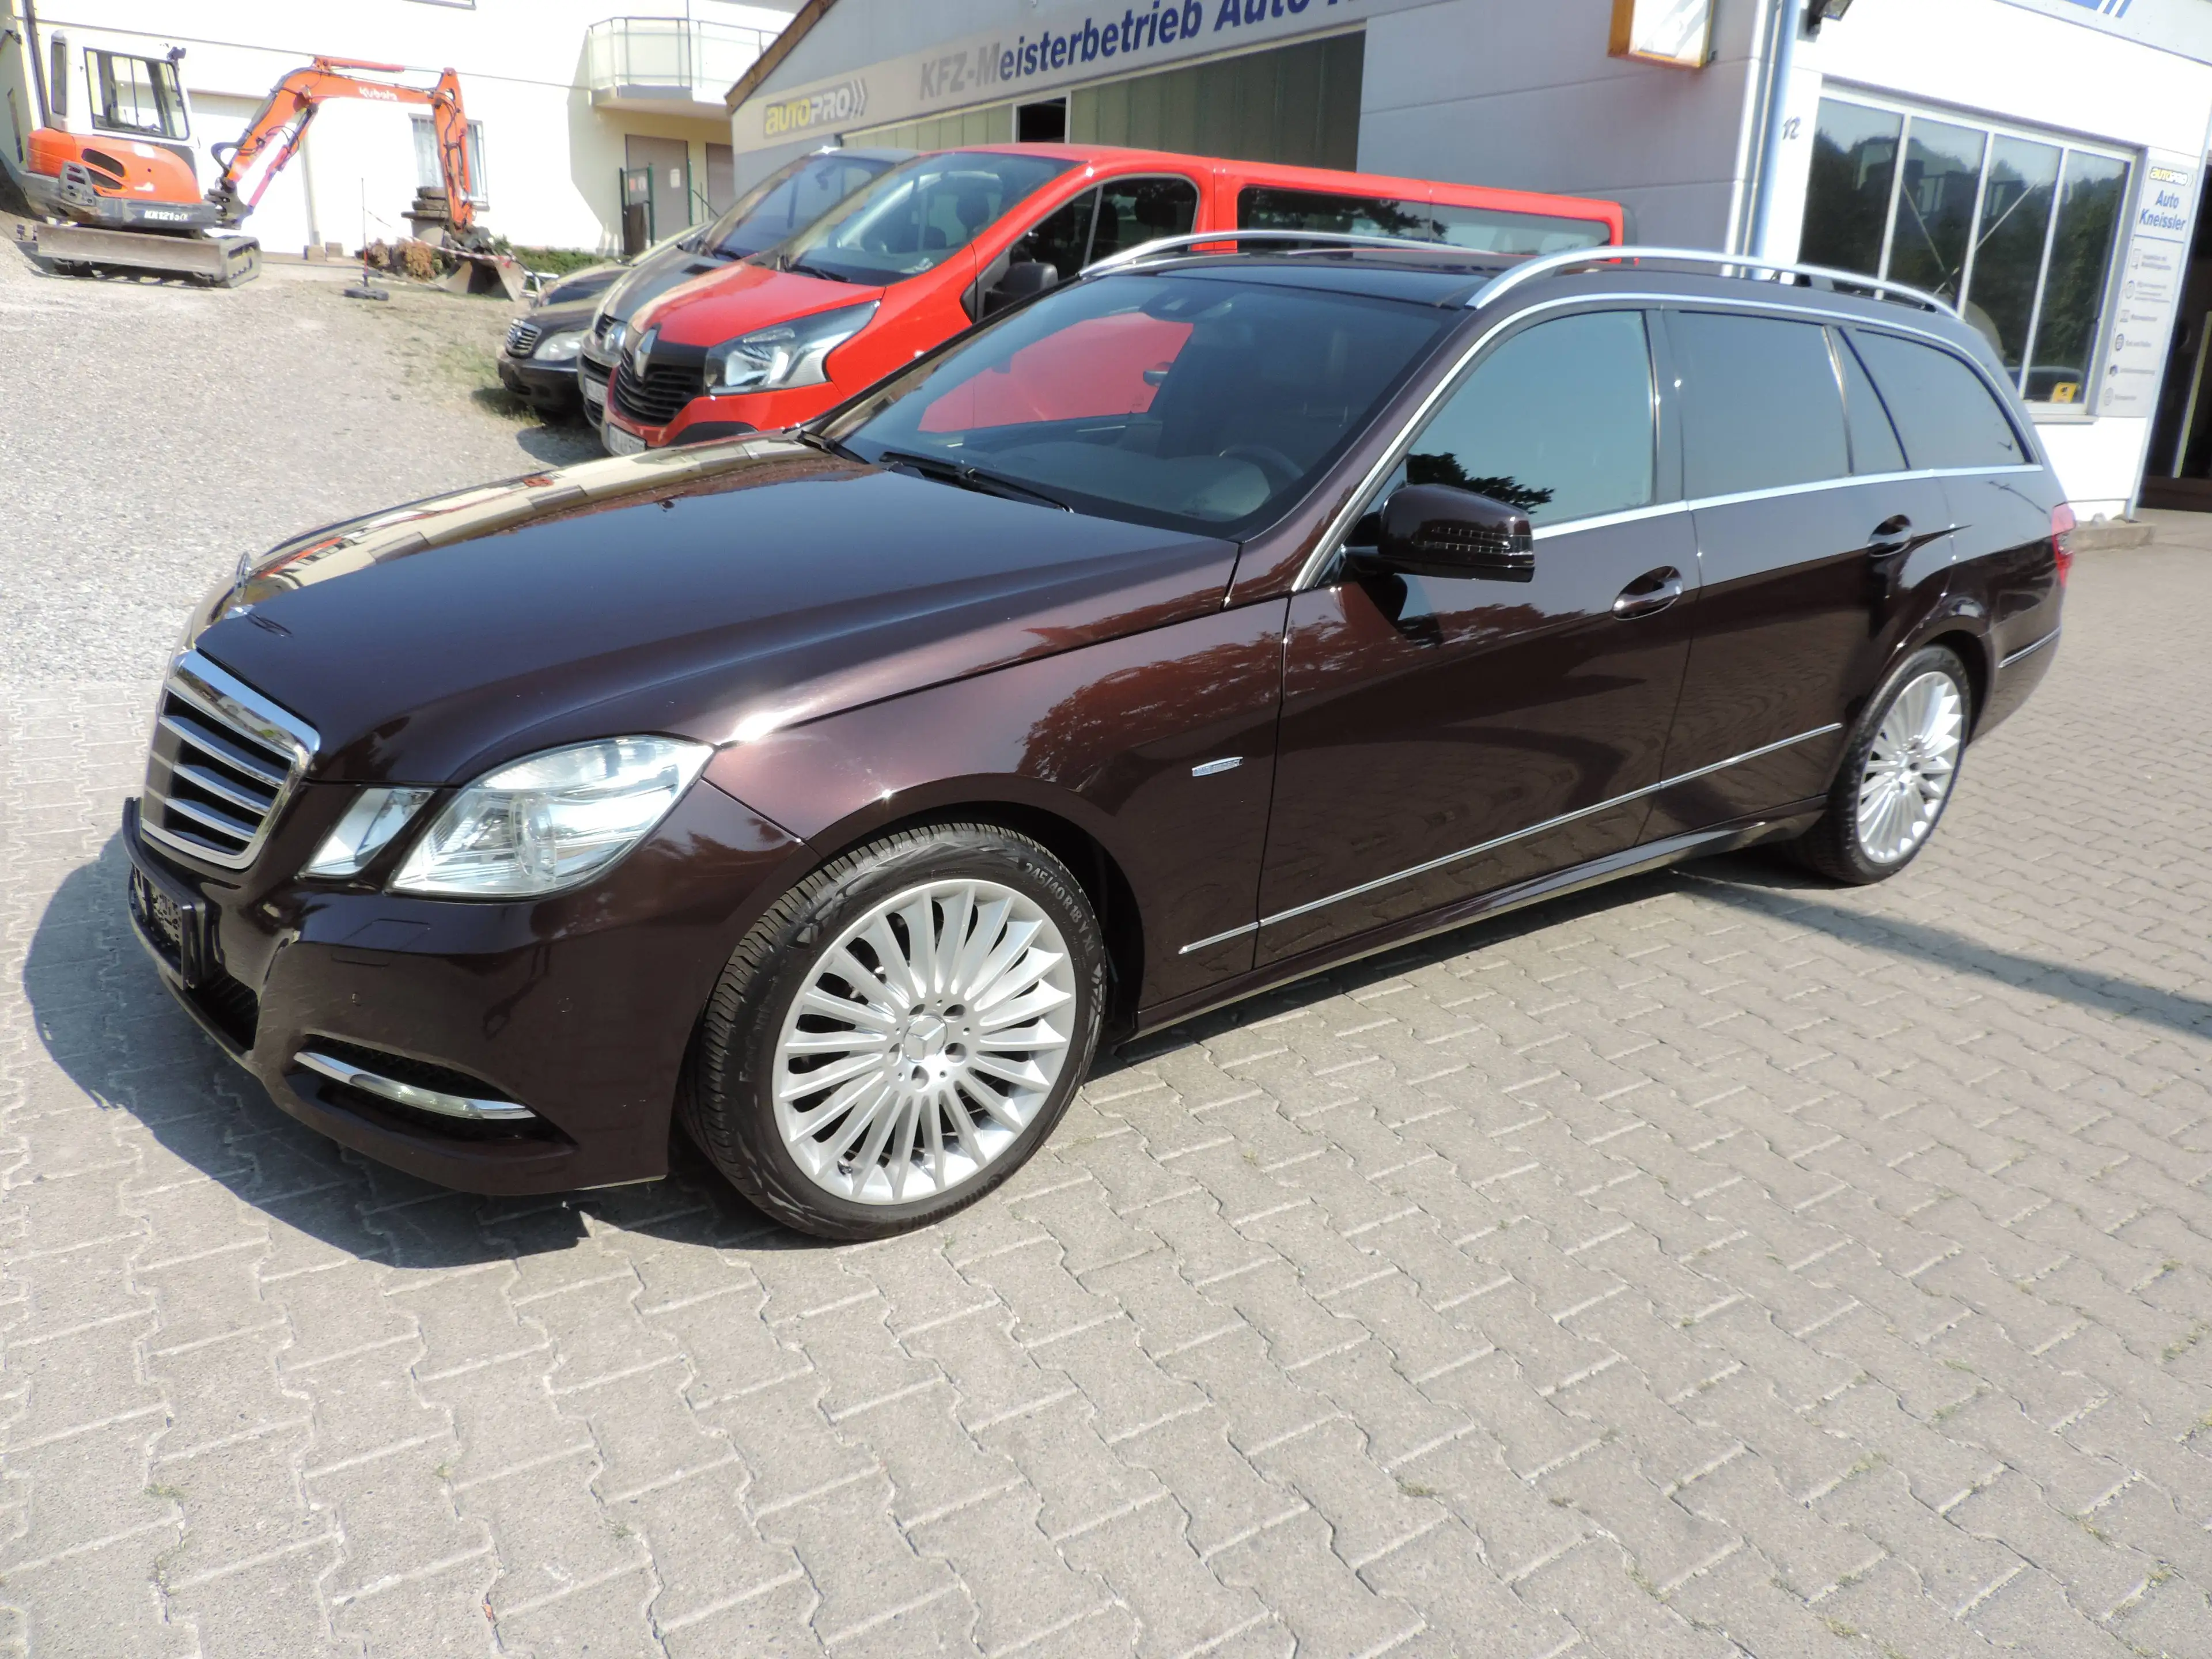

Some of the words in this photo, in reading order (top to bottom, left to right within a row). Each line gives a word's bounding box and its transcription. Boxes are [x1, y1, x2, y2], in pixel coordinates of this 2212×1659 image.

[920, 0, 1202, 100] KFZ-Meisterbetrieb
[359, 87, 397, 101] Kubota
[1782, 116, 1801, 140] 12
[2156, 190, 2179, 209] Auto
[2139, 208, 2186, 230] Kneissler
[1026, 862, 1066, 900] 245/40
[1078, 921, 1089, 934] Y
[1082, 934, 1095, 956] XL
